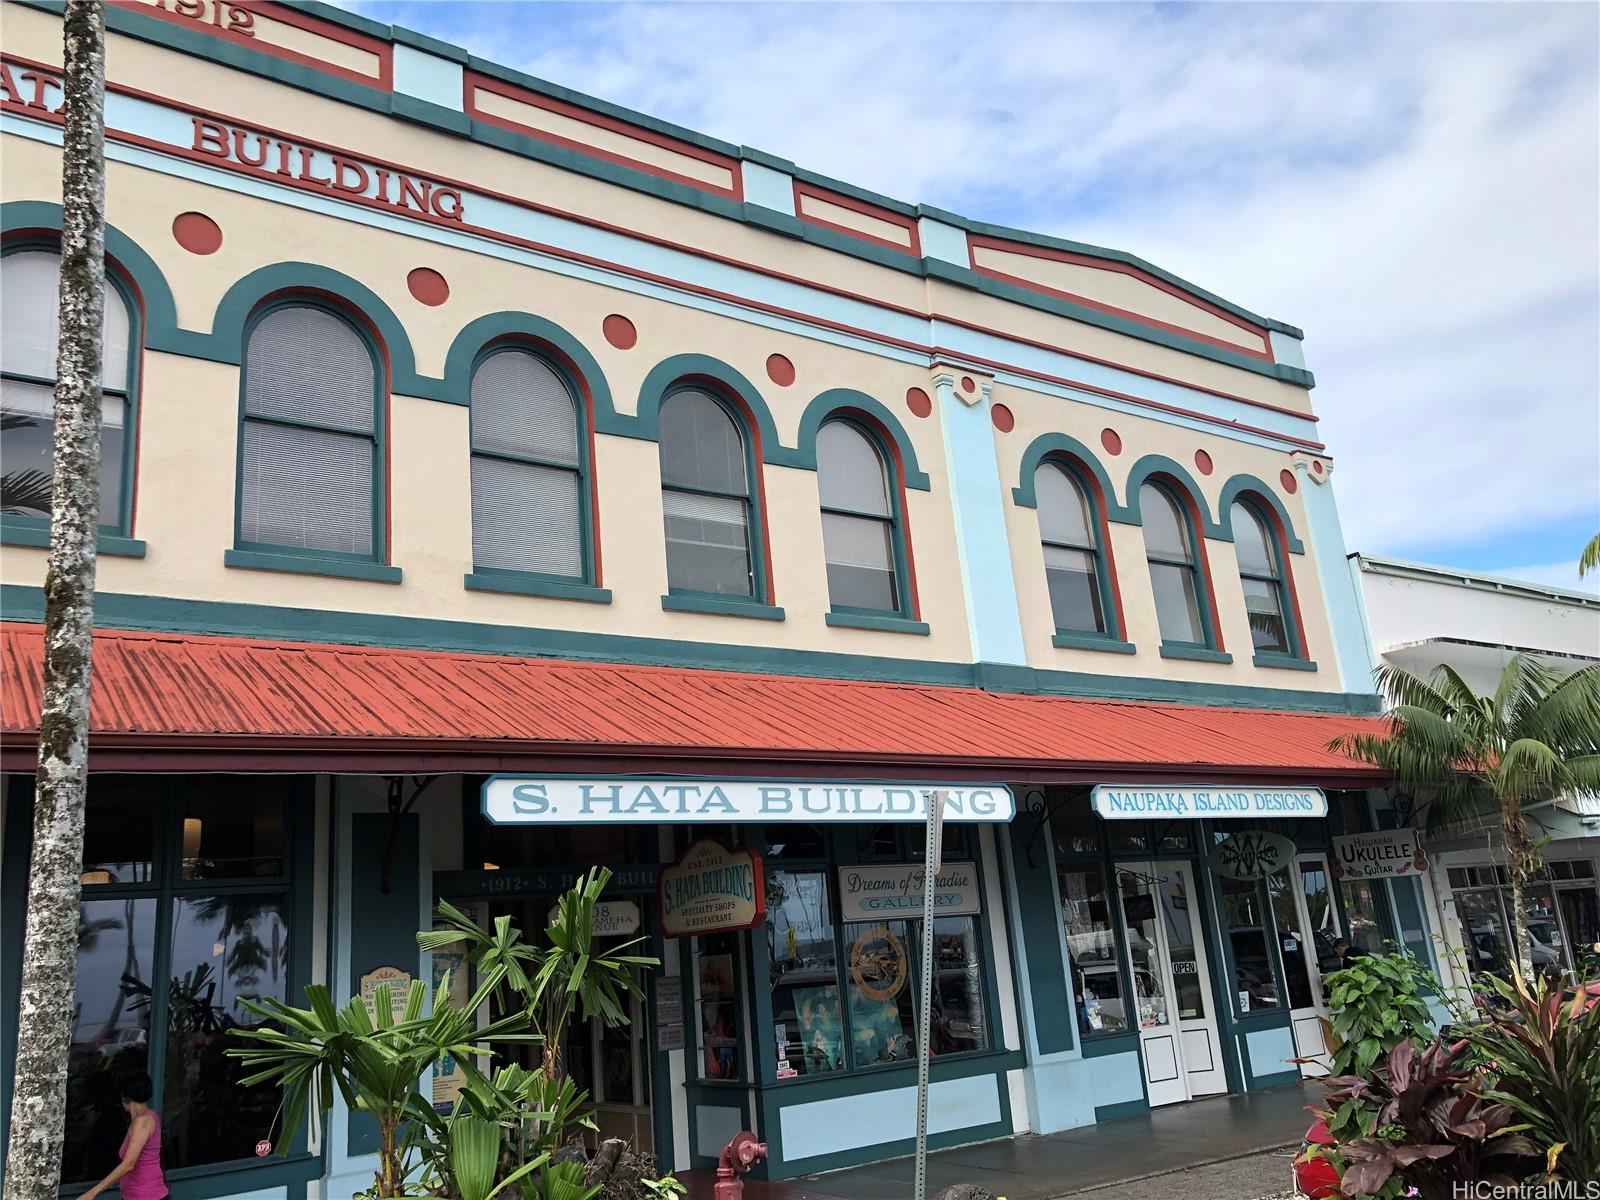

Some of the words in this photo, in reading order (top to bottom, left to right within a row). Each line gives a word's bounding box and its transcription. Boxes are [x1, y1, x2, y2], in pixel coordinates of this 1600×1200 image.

[155, 0, 256, 37] 912
[191, 116, 465, 223] BUILDING
[512, 784, 558, 814] S.
[578, 785, 740, 814] HATA
[758, 786, 997, 815] BUILDING
[1108, 791, 1190, 815] NAUPAKA
[1193, 792, 1250, 812] ISLAND
[1253, 792, 1314, 812] DESIGNS
[1341, 843, 1412, 863] UKULELE
[617, 872, 656, 886] BUIL
[1364, 865, 1393, 876] GUITAR
[675, 874, 701, 909] HATA
[702, 864, 753, 902] BUILDING
[847, 872, 896, 894] Dreams
[899, 871, 913, 896] of
[912, 870, 969, 891] Pradise
[681, 904, 713, 917] SPECIALTY
[714, 901, 736, 912] SHOPS
[691, 913, 732, 926] RESTAURANT
[1174, 962, 1195, 973] OPEN
